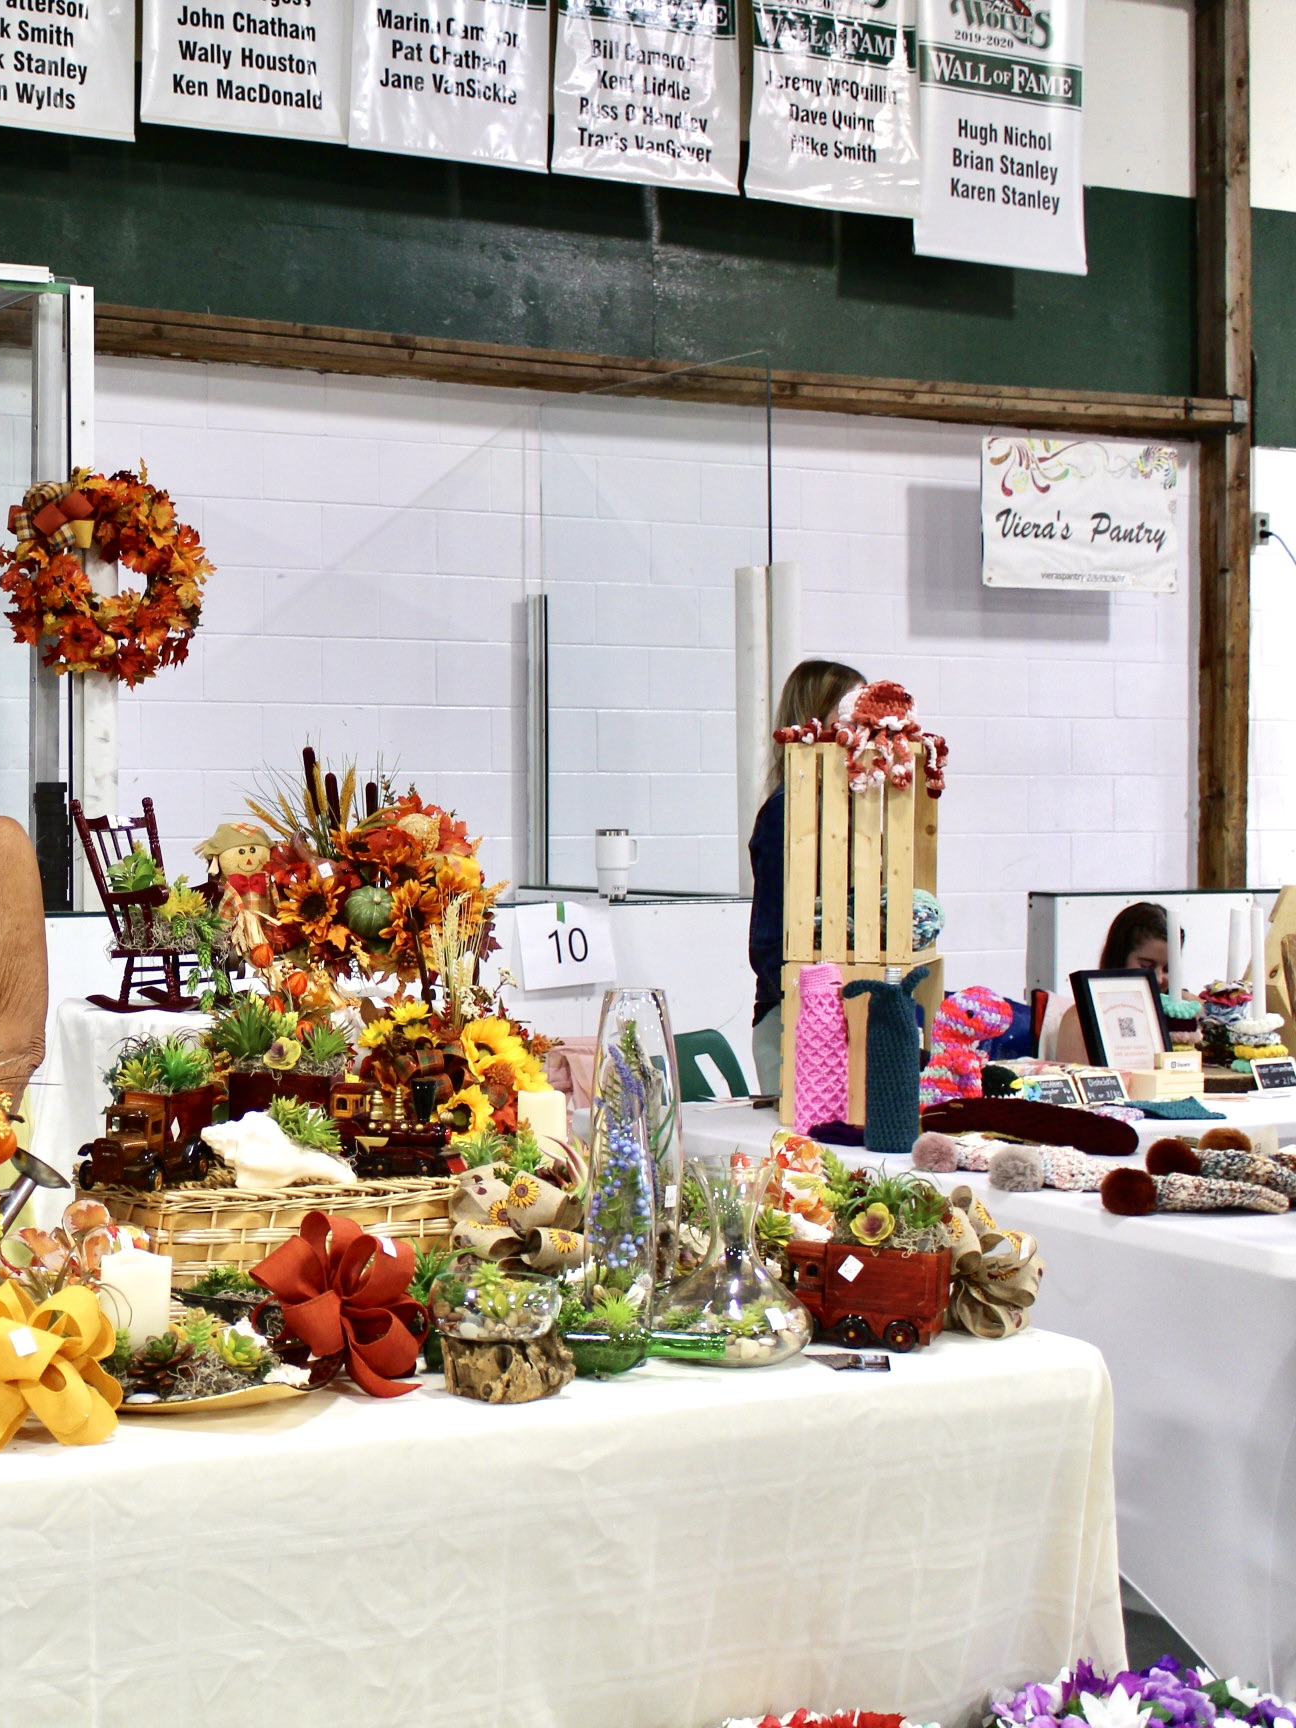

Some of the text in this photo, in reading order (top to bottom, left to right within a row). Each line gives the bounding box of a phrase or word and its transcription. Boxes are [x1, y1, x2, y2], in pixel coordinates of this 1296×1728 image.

[18, 20, 74, 47] Smith
[177, 5, 316, 42] John Chatham
[447, 18, 521, 49] Camon
[755, 12, 824, 47] WALL
[954, 30, 1014, 49] 2019-2020
[13, 50, 88, 85] Stanley
[178, 40, 316, 76] Wally Houston
[392, 39, 506, 75] Pat Chatham
[592, 39, 696, 72] Bill Cameron
[173, 73, 322, 110] Ken MacDonald
[380, 68, 517, 105] Jane VanSickle
[598, 70, 690, 101] Kent Liddle
[765, 70, 822, 97] Jeremy
[930, 51, 1073, 98] WALL OF FAME
[16, 82, 76, 110] Wylds
[579, 96, 618, 121] Russ
[789, 103, 875, 133] Dave Quinn
[958, 118, 1051, 150] Hugh Nichol
[578, 127, 628, 152] Travis
[791, 135, 877, 163] Mike Smith
[953, 147, 1058, 186] Brian Stanley
[950, 177, 1060, 216] Karen Stanley
[995, 508, 1167, 552] Viera's Pantry
[548, 927, 589, 964] 10
